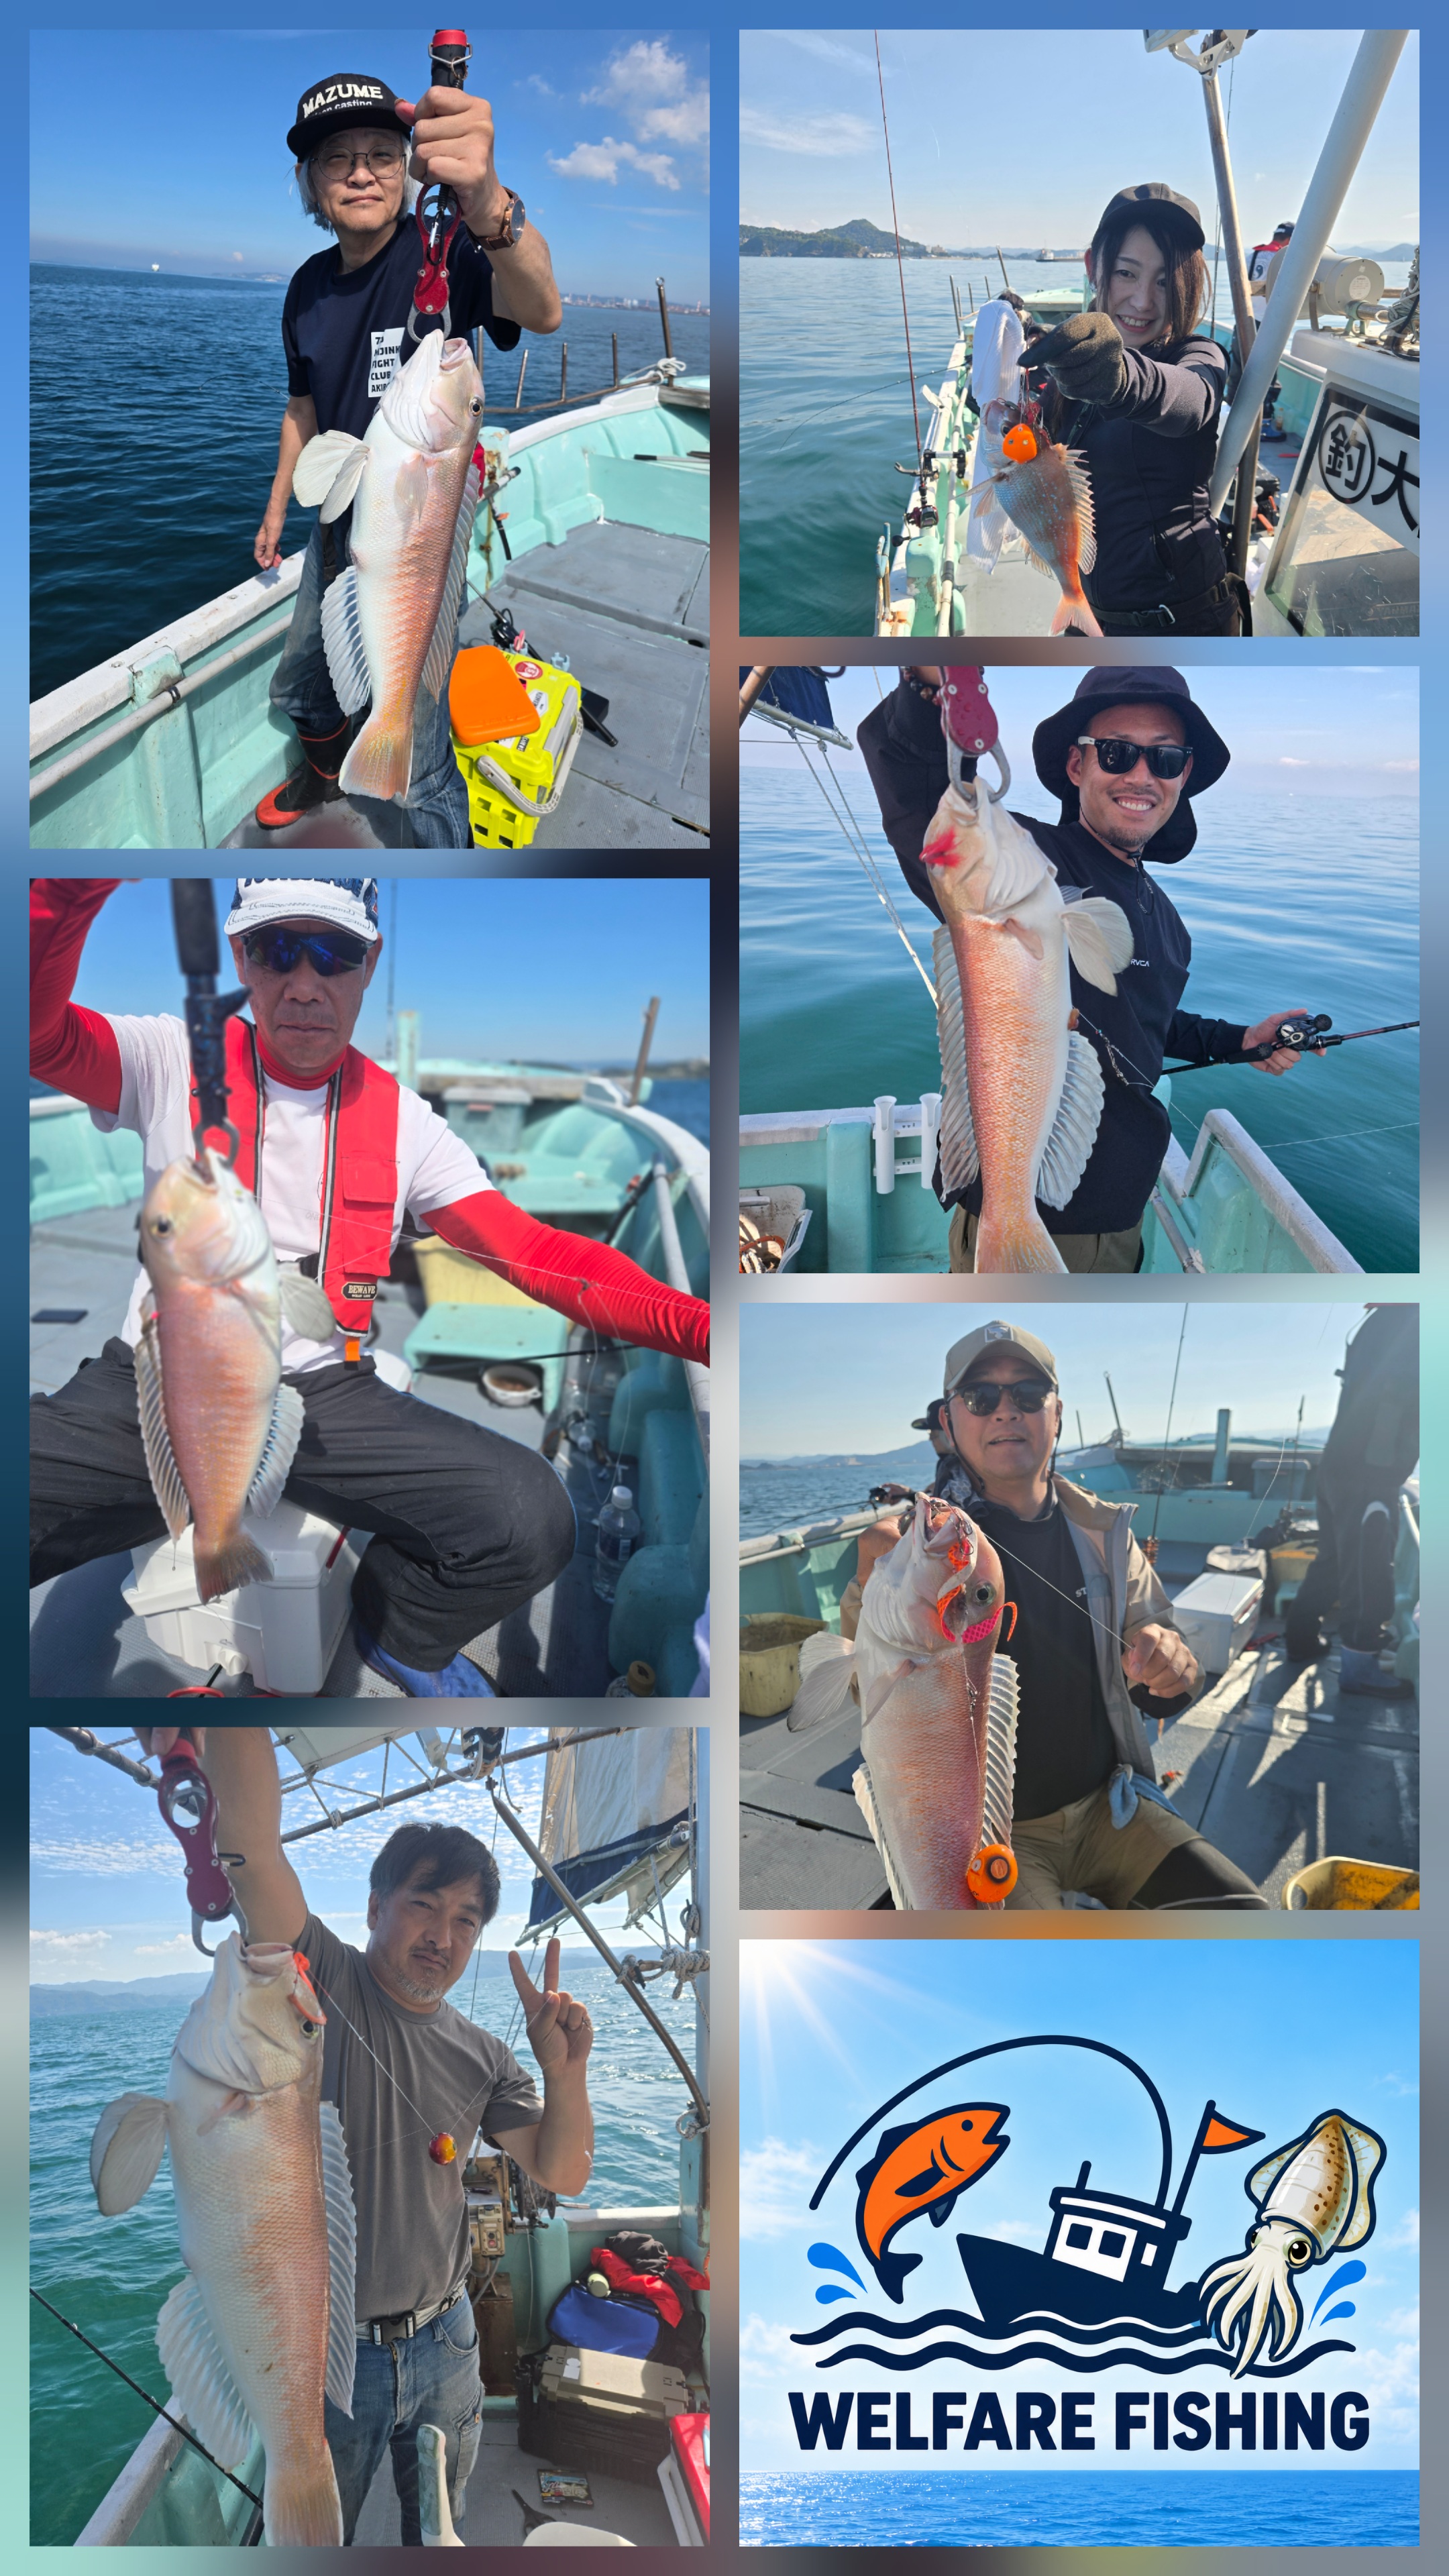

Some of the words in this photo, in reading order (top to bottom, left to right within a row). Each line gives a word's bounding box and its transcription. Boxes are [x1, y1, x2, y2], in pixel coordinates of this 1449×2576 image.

[303, 83, 384, 118] MAZUME
[370, 371, 391, 380] CLUB
[371, 382, 390, 392] AKIB
[1130, 959, 1150, 967] RVCA
[347, 1285, 376, 1294] BEWAVE
